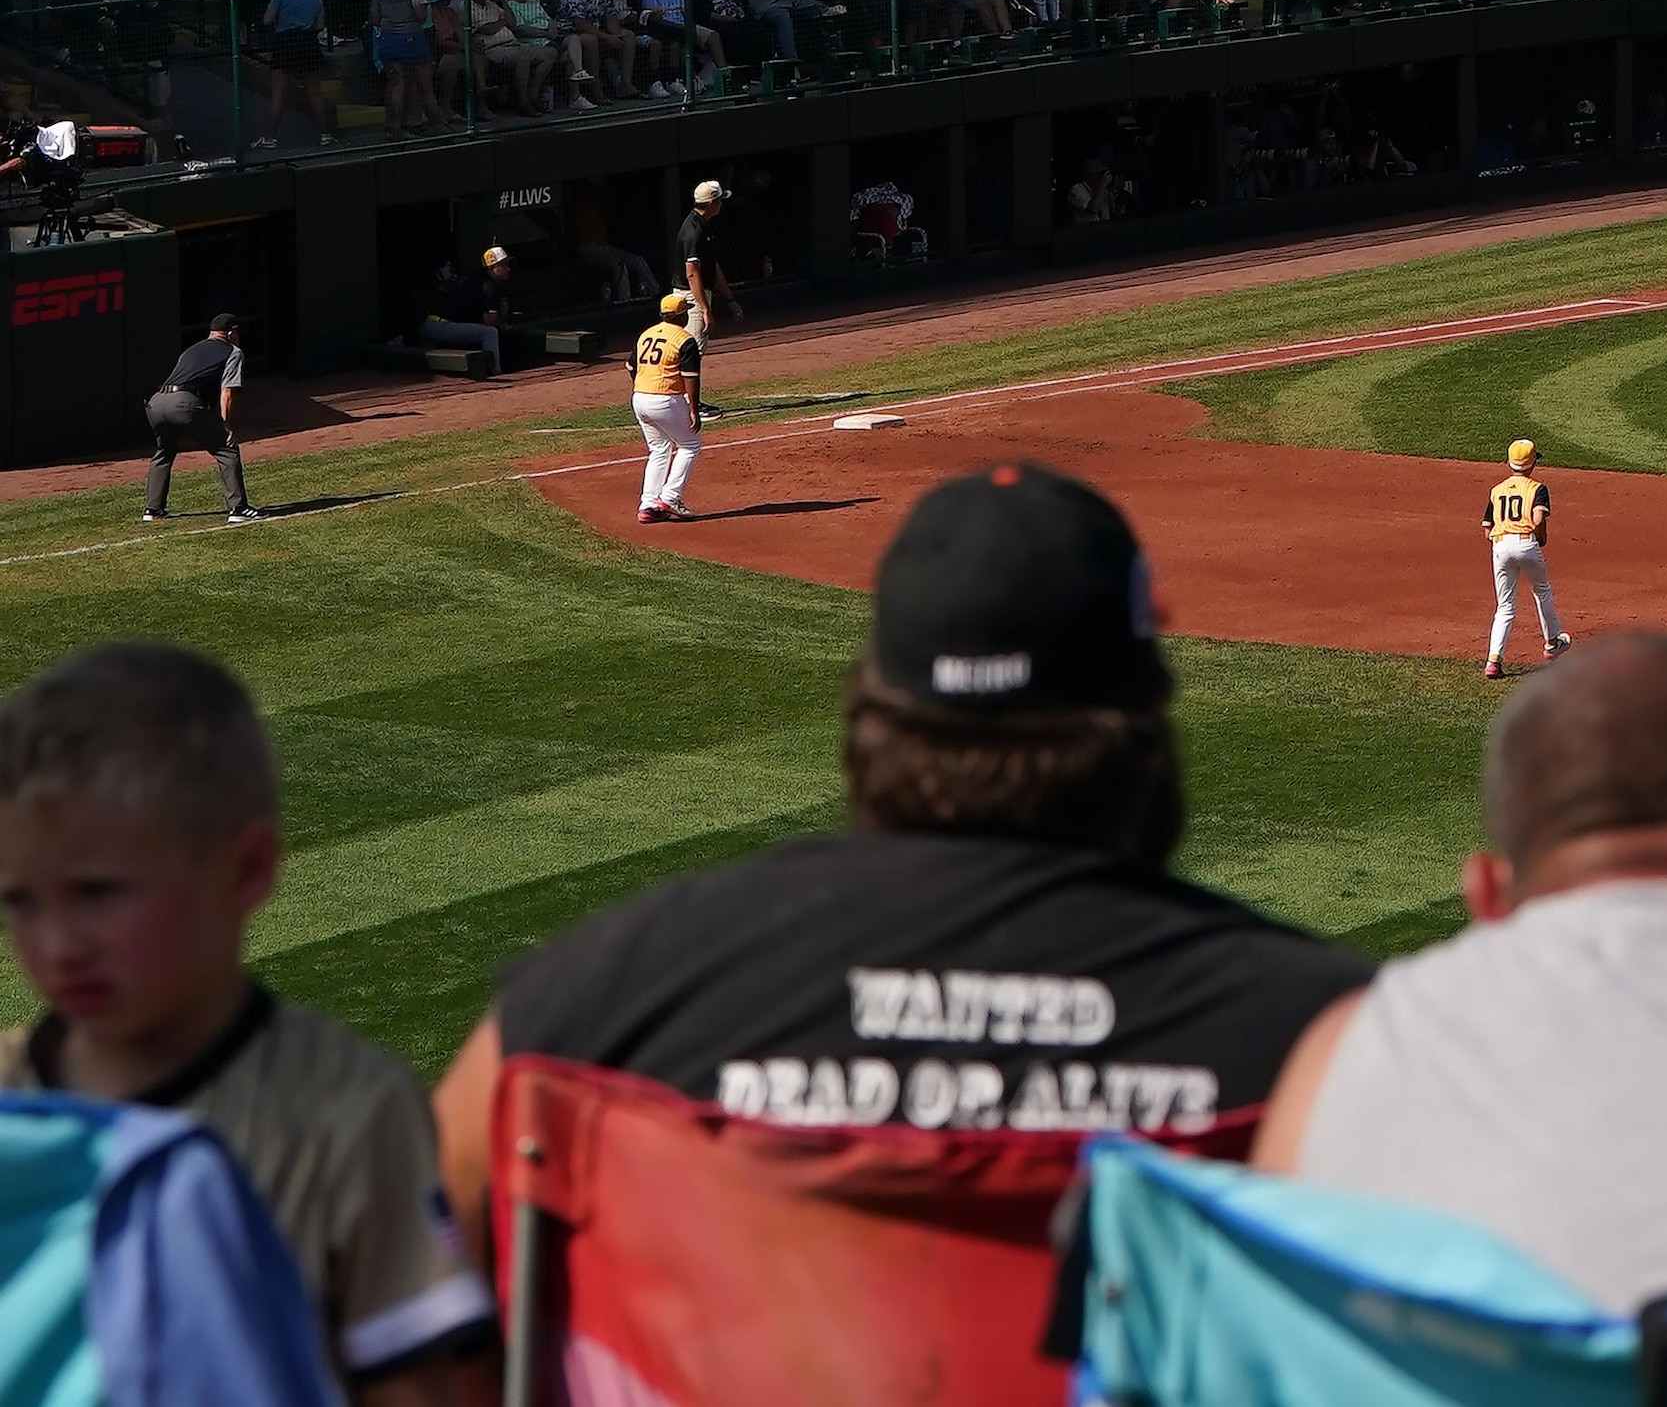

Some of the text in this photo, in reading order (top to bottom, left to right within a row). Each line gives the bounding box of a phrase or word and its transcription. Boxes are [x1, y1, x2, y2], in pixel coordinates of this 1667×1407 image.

[499, 186, 551, 209] #LLWS
[13, 268, 126, 327] ESPN
[640, 337, 667, 365] 25
[1499, 496, 1523, 522] 10
[847, 966, 1116, 1046] WANTED
[718, 1056, 1219, 1135] DEAD OR ALIVE
